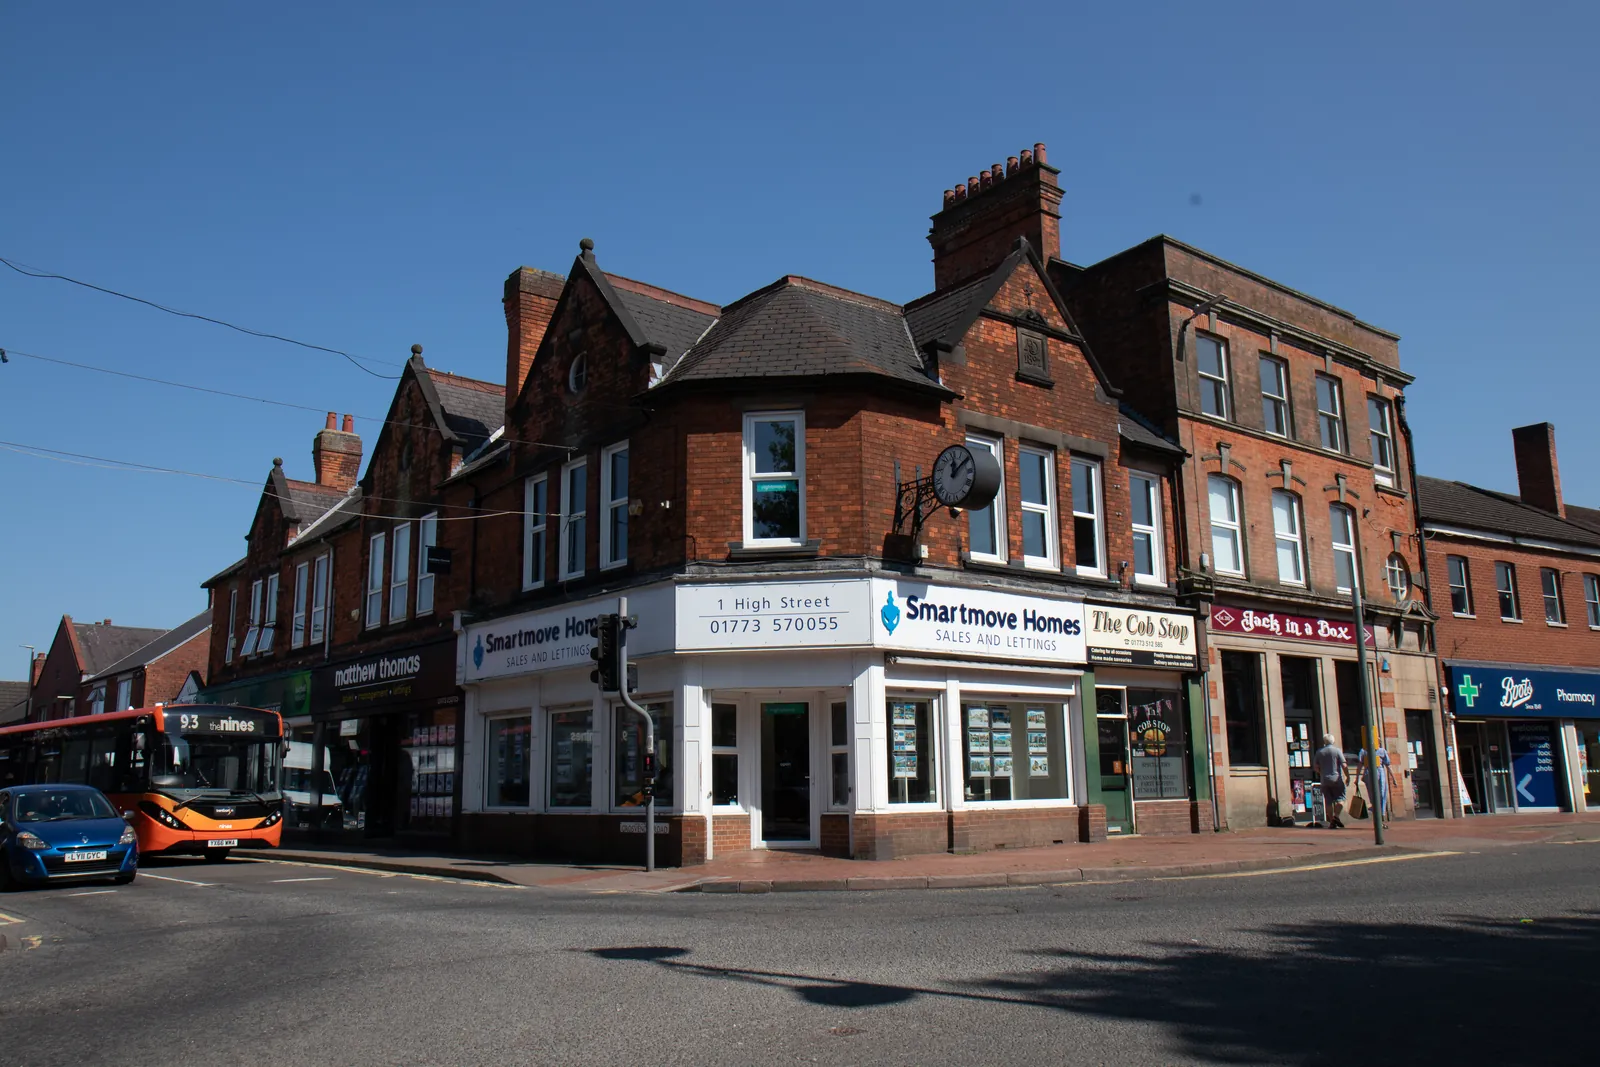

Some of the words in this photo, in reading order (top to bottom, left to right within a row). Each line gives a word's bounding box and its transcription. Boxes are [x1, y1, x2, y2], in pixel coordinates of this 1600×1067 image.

[717, 599, 723, 611] 1
[735, 597, 771, 613] High
[781, 596, 830, 609] Street
[906, 594, 1018, 630] Smartmove
[1023, 608, 1081, 636] Homes
[486, 624, 560, 654] Smartmove
[565, 616, 599, 639] Hom
[710, 619, 761, 634] 01773
[773, 616, 838, 632] 570055
[1092, 610, 1121, 634] The
[1126, 613, 1154, 636] Cob
[1158, 617, 1189, 645] Stop
[1240, 610, 1282, 636] Jack
[1285, 618, 1302, 636] in
[1304, 623, 1313, 636] a
[1317, 619, 1352, 640] Box
[935, 629, 971, 644] SALES
[977, 633, 1001, 646] AND
[1006, 636, 1057, 651] LETTINGS
[506, 653, 528, 668] SALES
[531, 651, 548, 663] AND
[551, 643, 590, 661] LETTINGS
[335, 662, 377, 687] matthew
[380, 654, 420, 679] thomas
[1500, 676, 1533, 708] Boots
[1556, 688, 1595, 706] Pharmacy
[1137, 720, 1151, 734] COB
[86, 851, 101, 860] GYC
